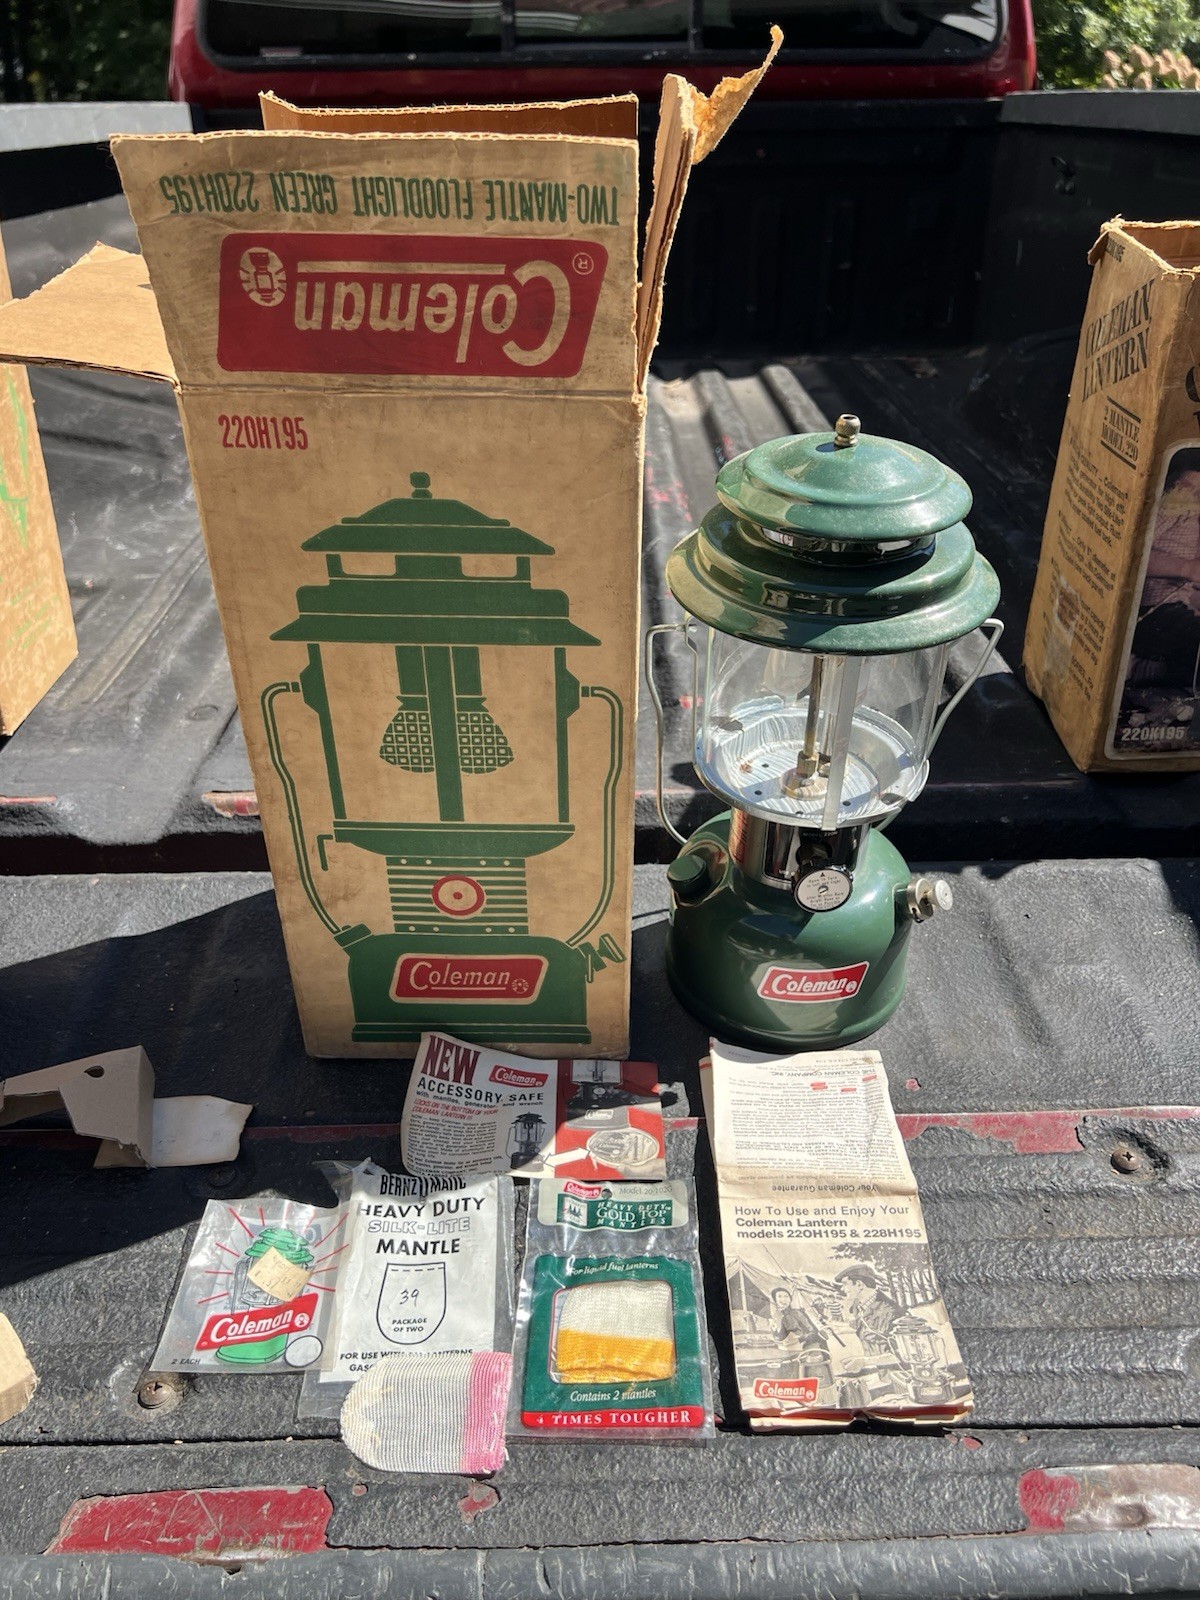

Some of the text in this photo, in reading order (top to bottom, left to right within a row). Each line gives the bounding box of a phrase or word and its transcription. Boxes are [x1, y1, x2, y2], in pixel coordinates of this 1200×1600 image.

[159, 169, 620, 226] TWO-MANTLE FLOODLIGHT GREEN 220H195
[294, 259, 571, 367] Coleman
[217, 414, 309, 450] 220H195
[1109, 408, 1140, 443] MANTLE
[1125, 440, 1139, 462] 220
[1120, 726, 1186, 741] 220K195
[409, 961, 511, 990] Coleman
[771, 974, 846, 995] Coleman
[421, 1035, 482, 1086] NEW
[494, 1067, 537, 1085] Coleman
[416, 1090, 429, 1099] with
[417, 1077, 545, 1103] ACCESSORY SAFE
[412, 1106, 439, 1116] COLEMAN
[440, 1101, 452, 1110] THE
[567, 1182, 594, 1198] Coleman
[619, 1186, 642, 1195] Model
[772, 1183, 878, 1193] Your Coleman Guarantee
[361, 1197, 486, 1218] HEAVY DUTY
[597, 1201, 633, 1210] HEAVY
[734, 1204, 910, 1218] How To Use and Enjoy Your
[596, 1207, 636, 1223] GOLD
[640, 1208, 667, 1221] TOP
[596, 1216, 666, 1229] MANTLES
[735, 1217, 848, 1228] Coleman Lantern
[367, 1216, 471, 1235] SILK-LITE
[737, 1228, 784, 1239] models
[850, 1228, 860, 1238] &
[863, 1227, 922, 1239] 228H195
[376, 1238, 460, 1256] MANTLE
[607, 1261, 625, 1272] fuel
[625, 1262, 659, 1271] lanterns
[210, 1309, 294, 1343] Coleman
[392, 1317, 428, 1325] PACKAGE
[406, 1325, 424, 1333] TWO
[340, 1352, 358, 1360] FOR
[361, 1351, 379, 1360] USE
[570, 1387, 657, 1402] Contains 2 mantles
[759, 1381, 806, 1399] Coleman
[536, 1410, 691, 1425] 4 TIMES TOUGHER
